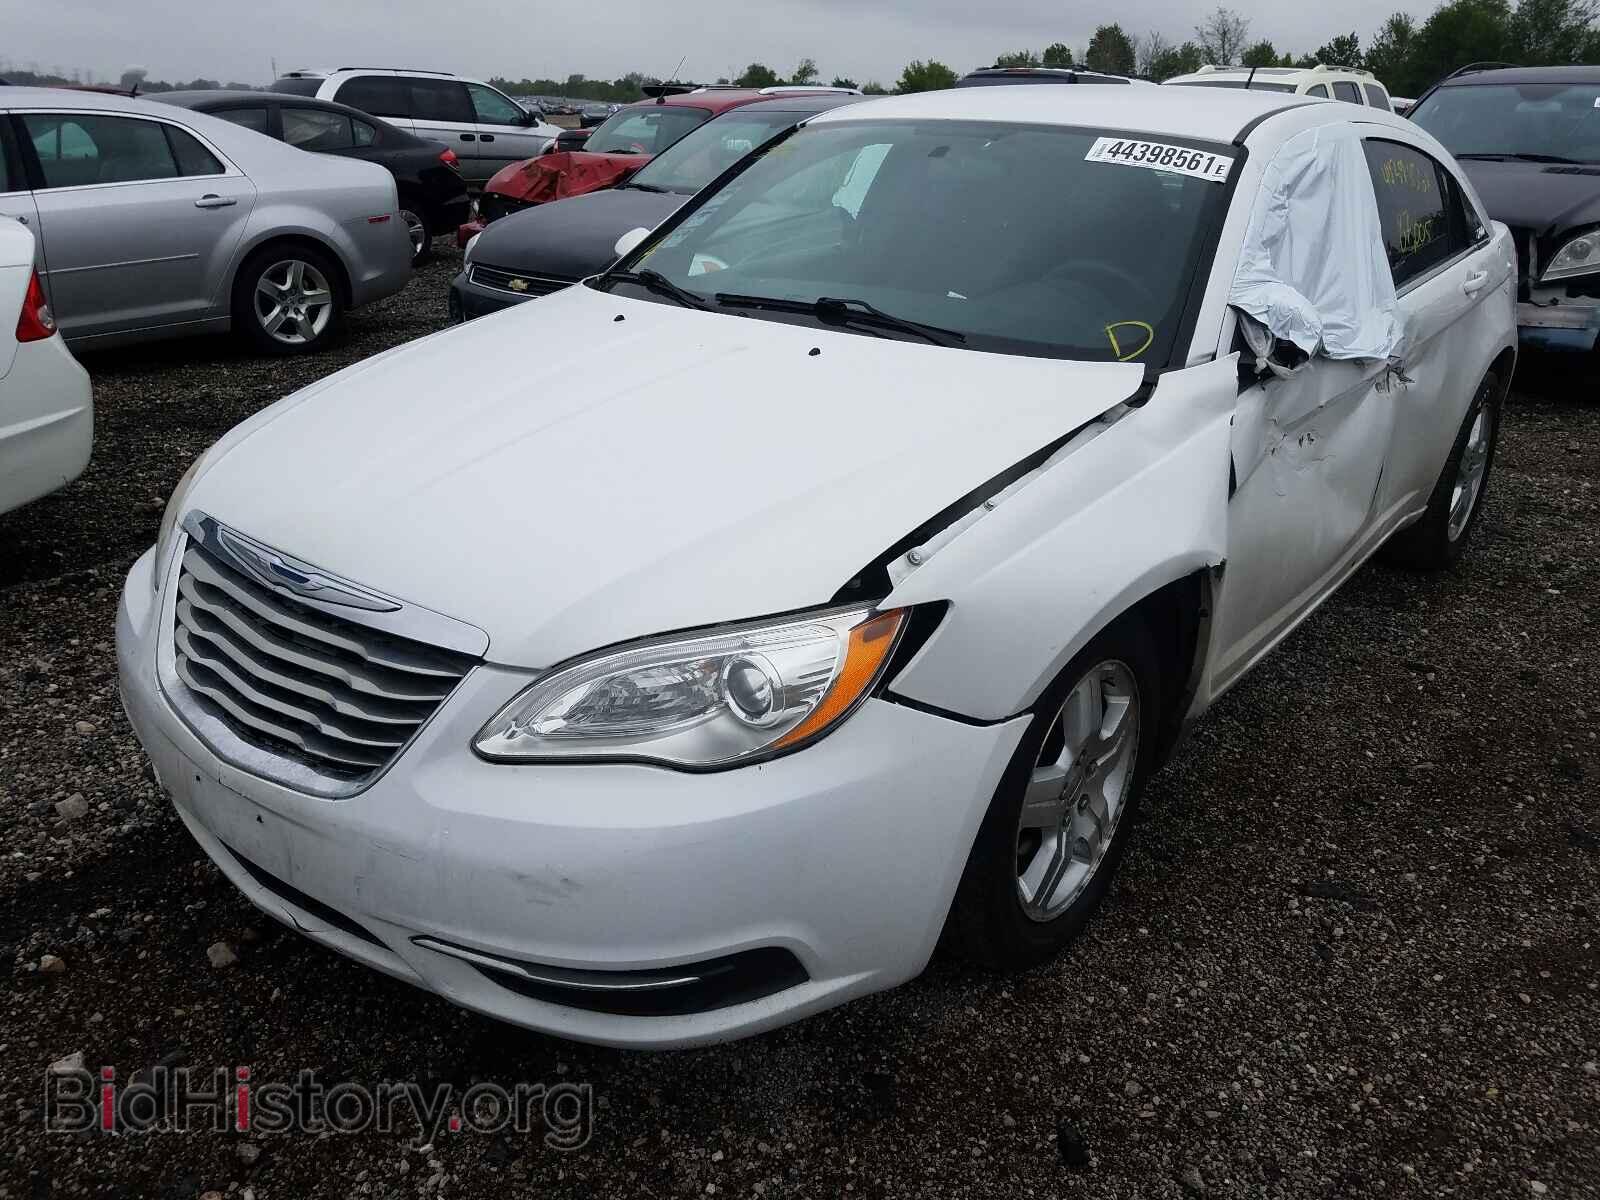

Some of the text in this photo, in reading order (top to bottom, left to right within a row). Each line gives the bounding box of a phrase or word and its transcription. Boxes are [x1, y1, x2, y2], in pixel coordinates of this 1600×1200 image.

[1107, 141, 1216, 174] 44398561
[1214, 164, 1226, 175] E
[1105, 320, 1154, 362] D
